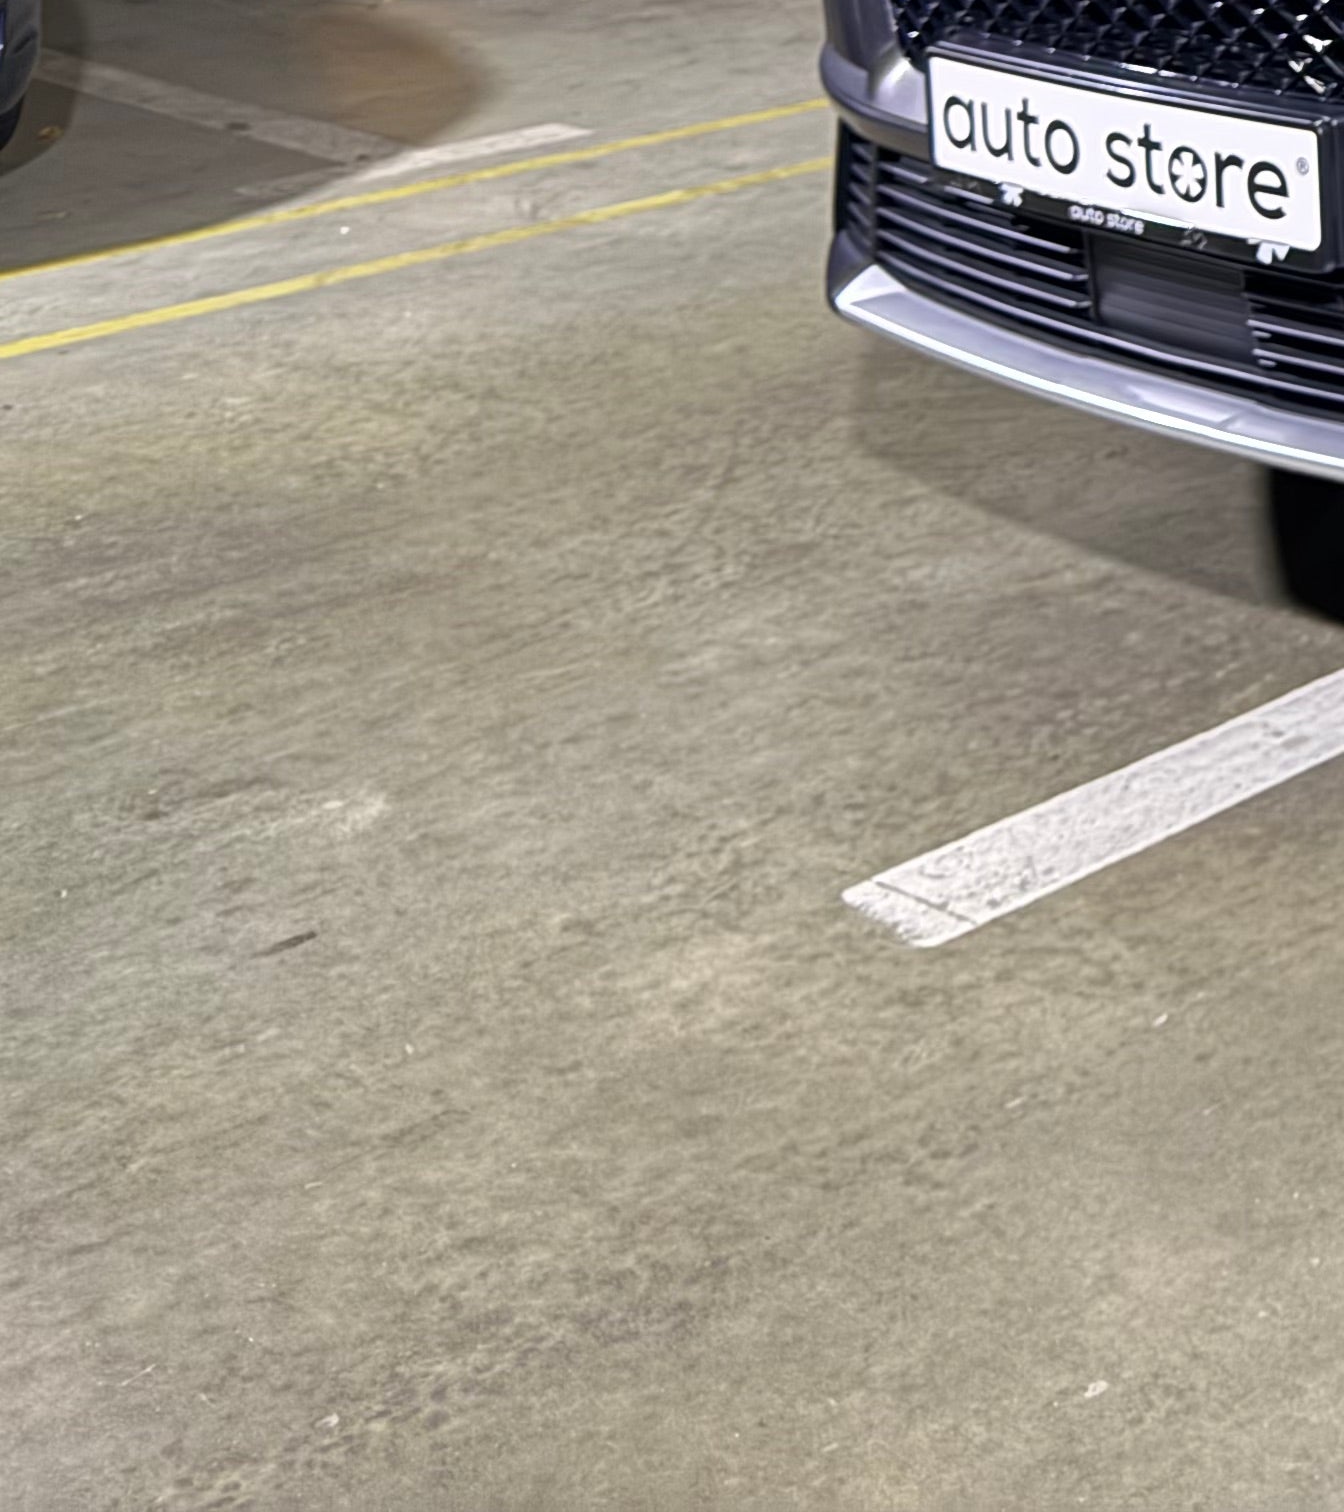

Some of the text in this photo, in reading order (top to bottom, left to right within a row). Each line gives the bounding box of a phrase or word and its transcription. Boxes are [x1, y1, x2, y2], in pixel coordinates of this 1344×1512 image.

[943, 95, 1080, 174] auto
[1068, 204, 1145, 235] auto store
